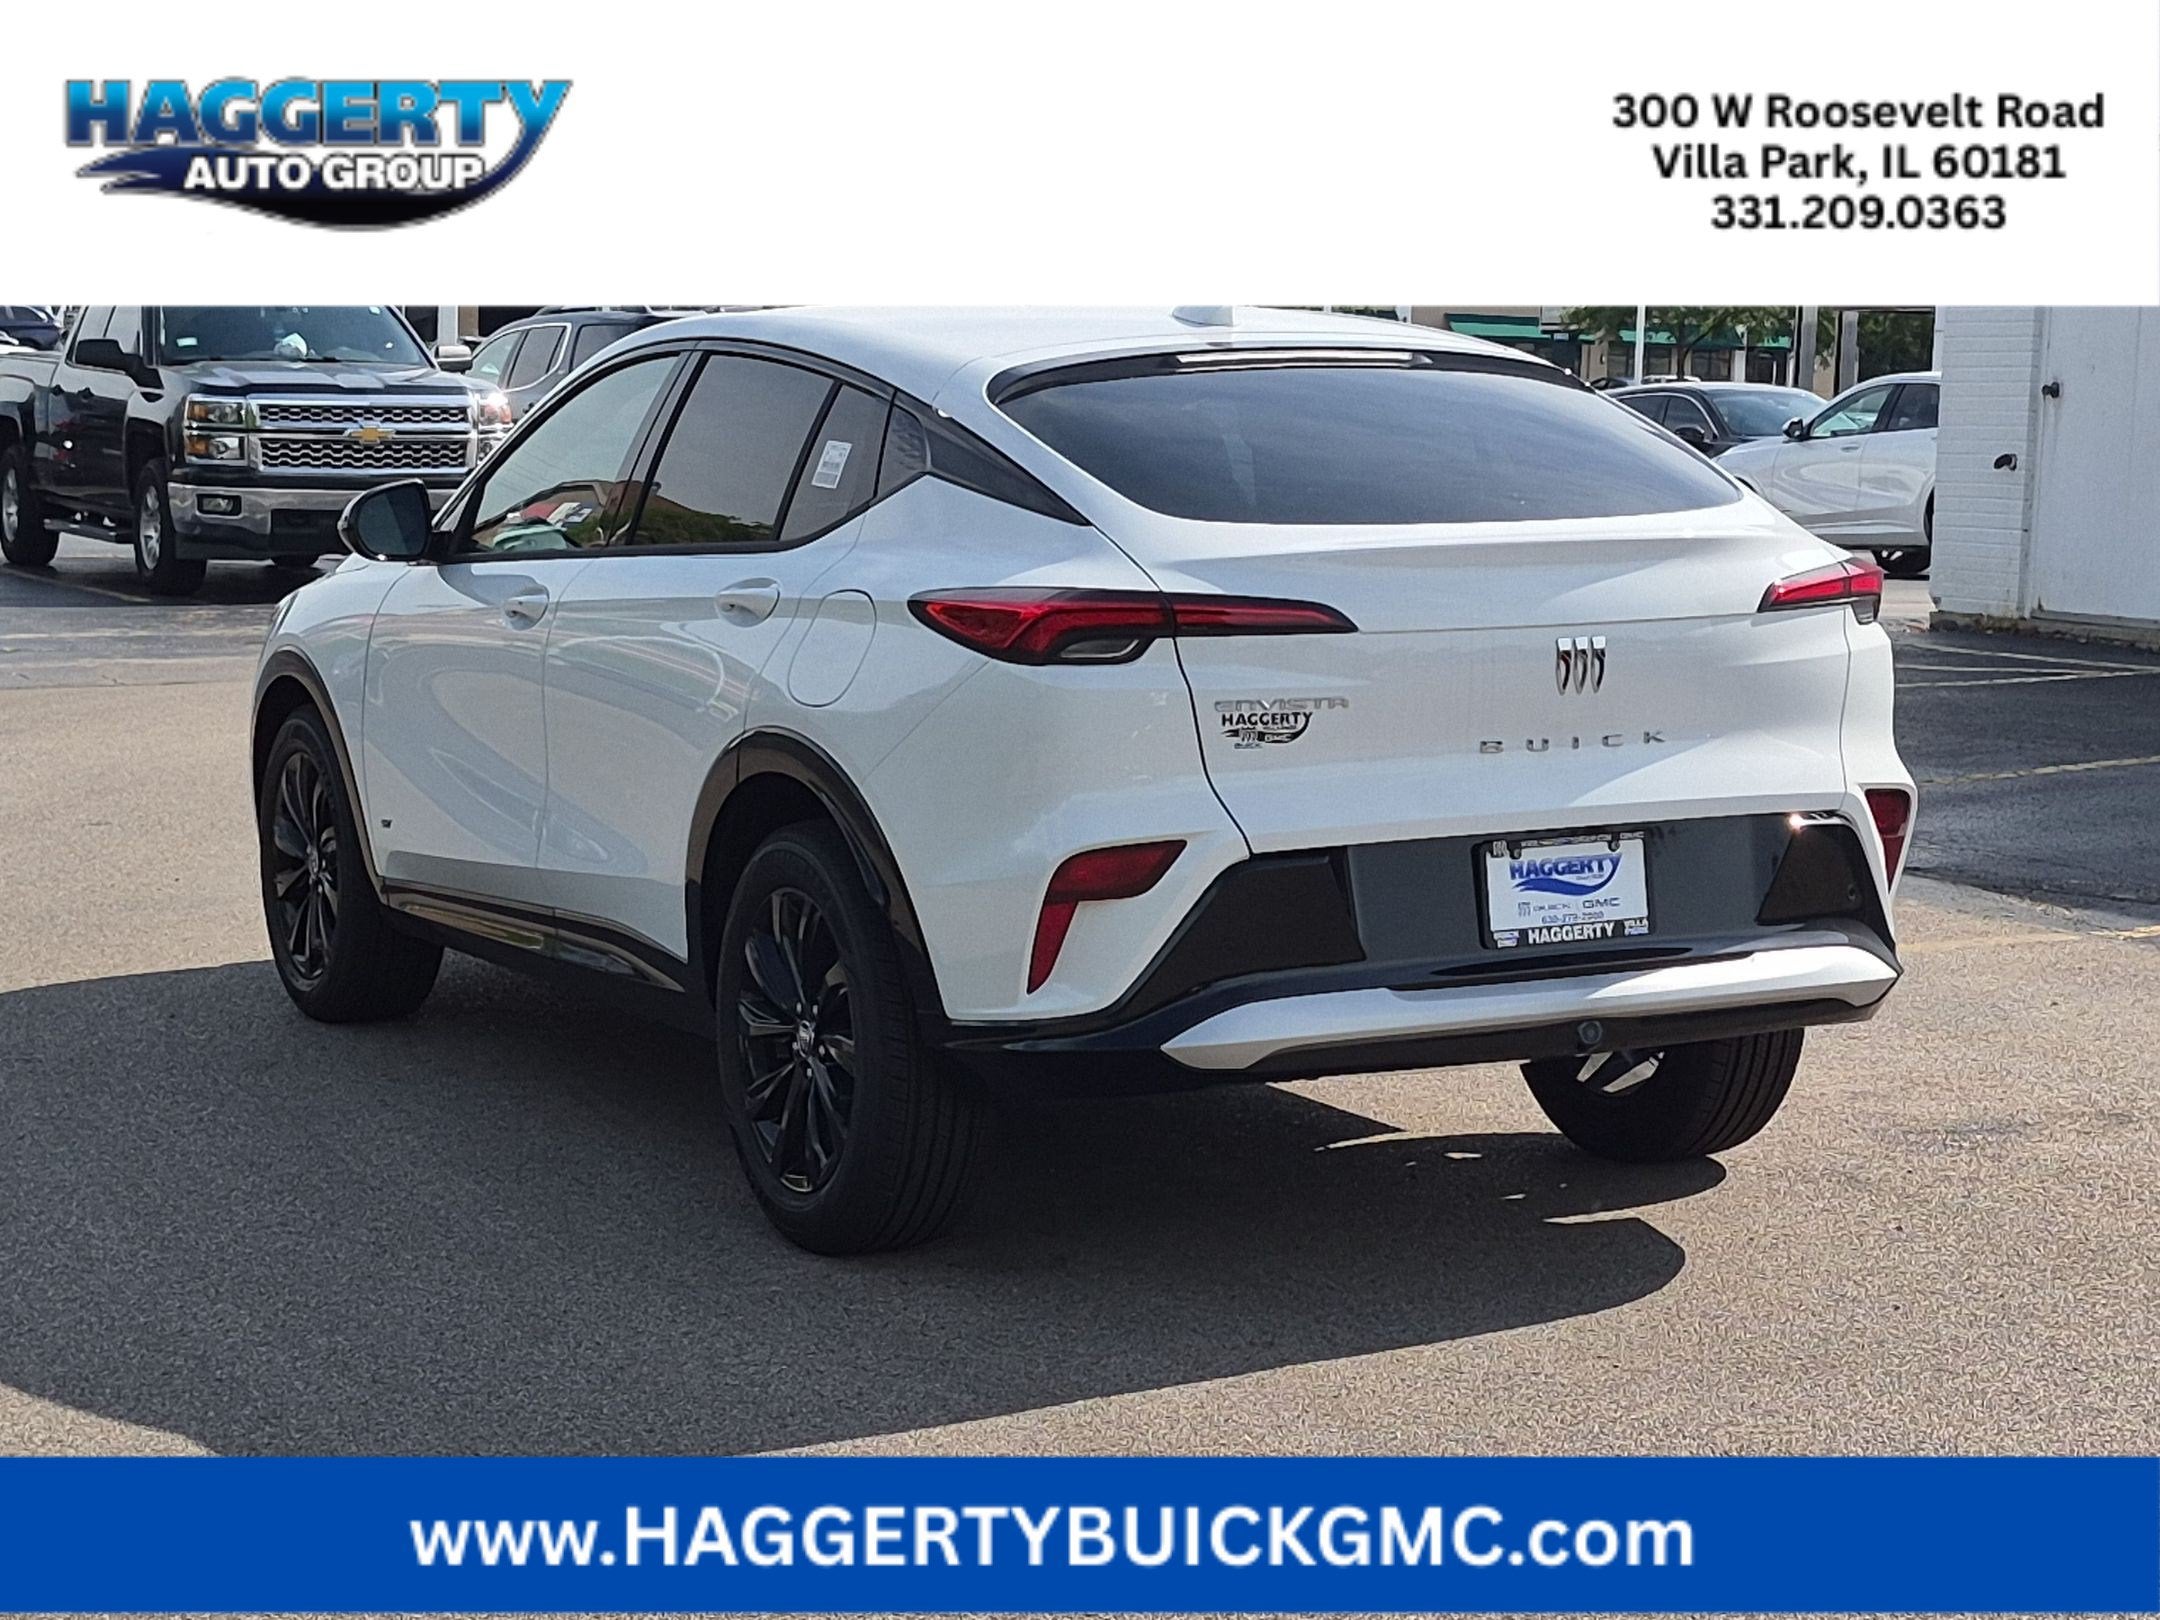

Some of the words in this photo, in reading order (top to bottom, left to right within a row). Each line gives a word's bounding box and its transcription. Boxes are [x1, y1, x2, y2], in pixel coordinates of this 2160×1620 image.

[1221, 711, 1313, 727] HAGGERTY
[1480, 731, 1666, 754] BUICK
[1509, 853, 1622, 881] HAGGERTY
[1582, 897, 1621, 909] GMC
[1528, 922, 1615, 945] HAGGERTY
